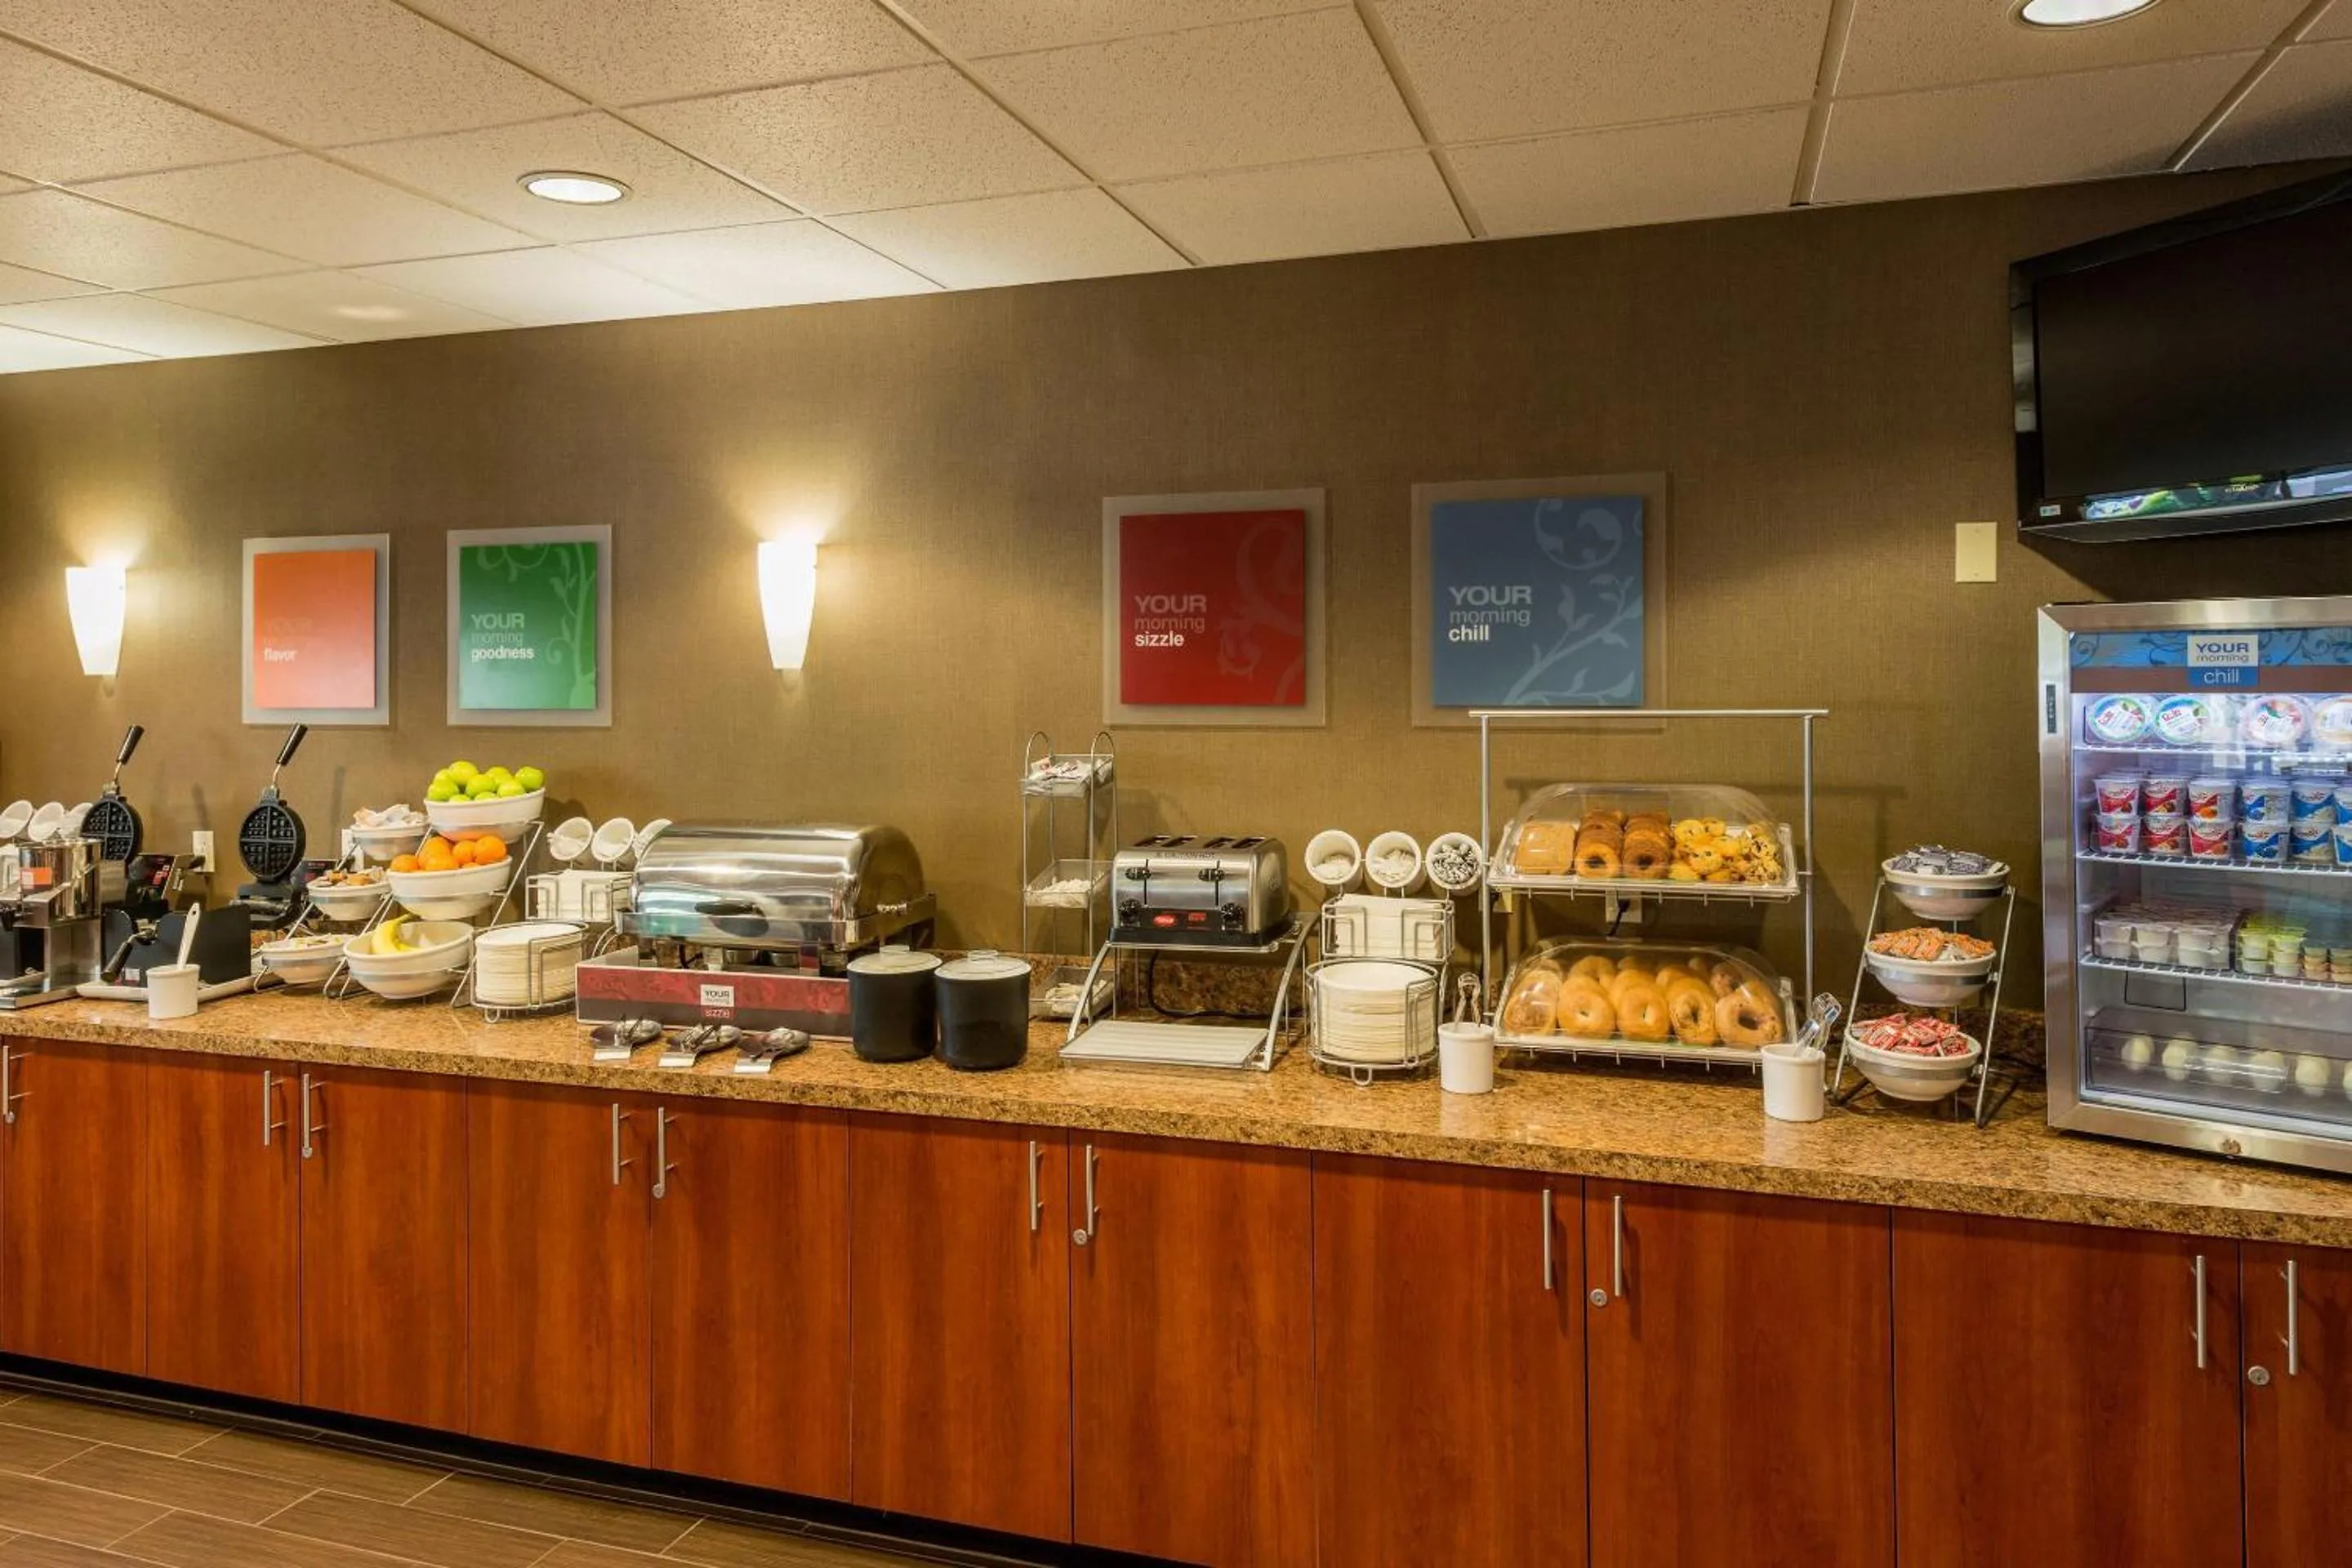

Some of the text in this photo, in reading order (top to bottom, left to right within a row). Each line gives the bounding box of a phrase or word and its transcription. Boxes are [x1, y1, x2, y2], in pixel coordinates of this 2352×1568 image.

[1134, 595, 1207, 613] YOUR
[1447, 586, 1532, 605] YOUR
[470, 612, 525, 630] YOUR
[1134, 615, 1205, 634] morning
[1449, 608, 1530, 626] morning
[1134, 630, 1184, 647] sizzle
[1449, 624, 1489, 641] chill
[264, 647, 297, 662] flavor
[471, 645, 535, 662] goodness
[2195, 642, 2249, 653] YOUR
[2204, 668, 2239, 684] chill
[705, 990, 730, 998] YOUR
